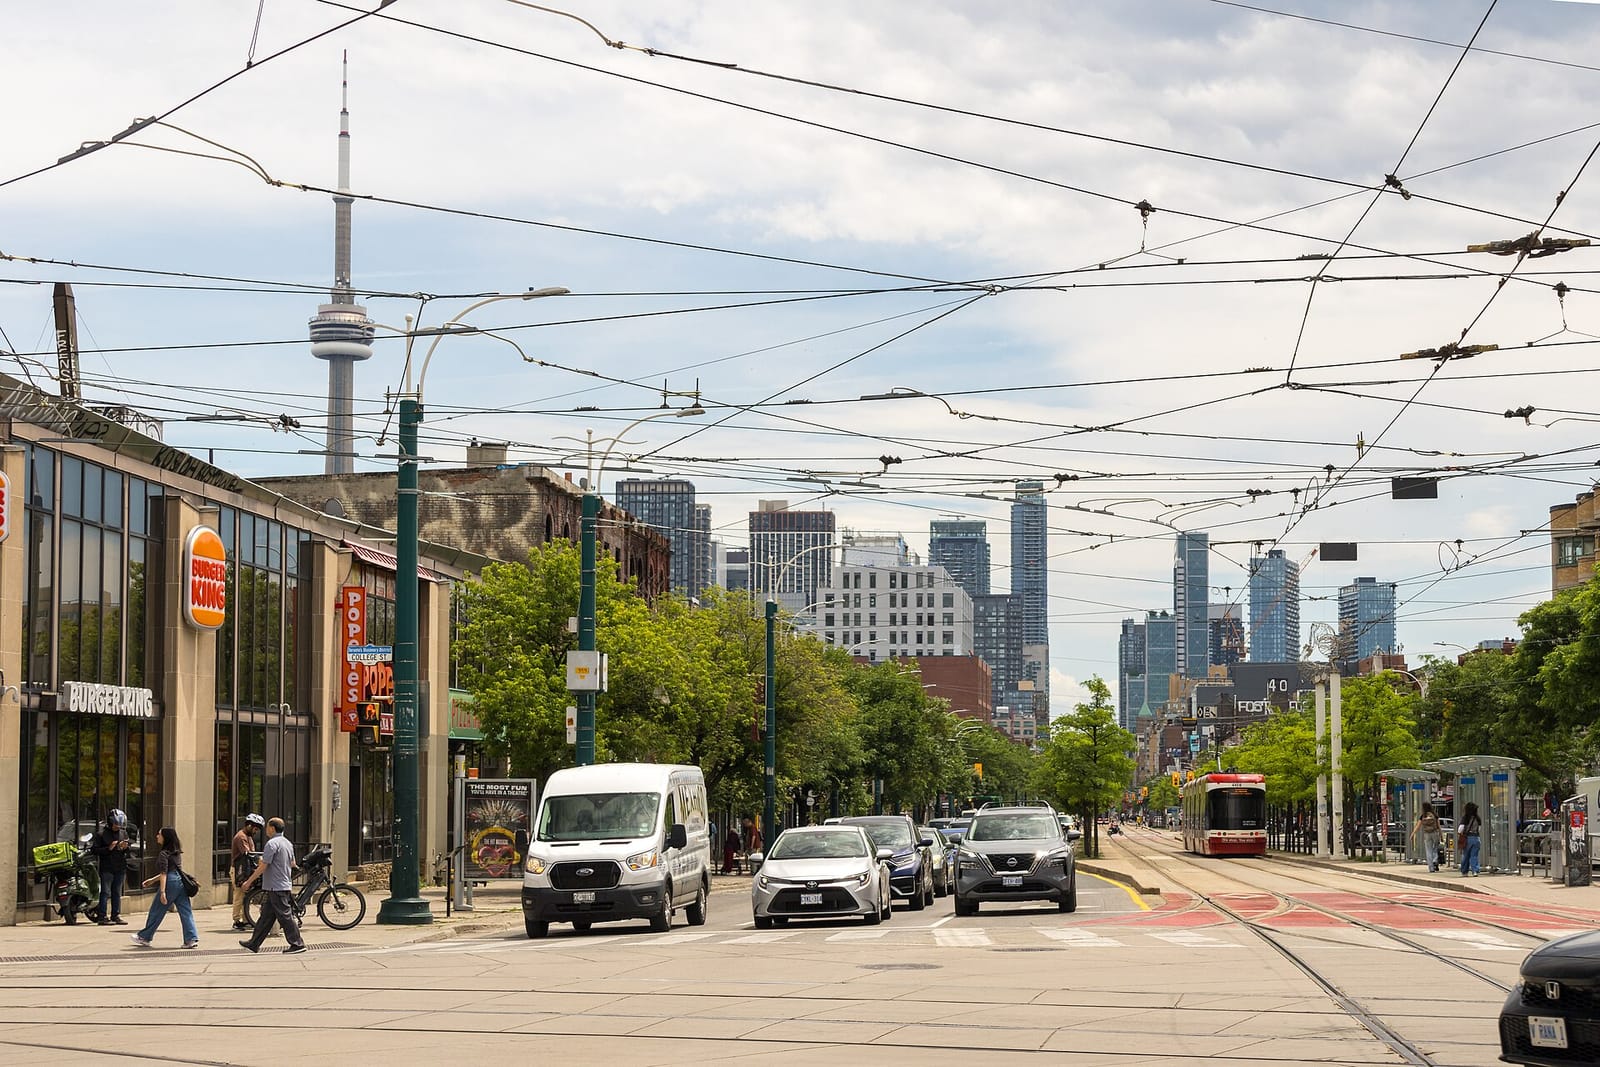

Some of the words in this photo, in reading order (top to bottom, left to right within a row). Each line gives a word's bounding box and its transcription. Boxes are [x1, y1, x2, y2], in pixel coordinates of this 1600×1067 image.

[192, 558, 225, 582] BURGER
[191, 579, 225, 610] KING
[351, 653, 377, 661] COLLEGE
[379, 653, 387, 661] ST
[1269, 679, 1288, 692] 40
[69, 682, 121, 715] BURGER
[122, 687, 153, 718] KING
